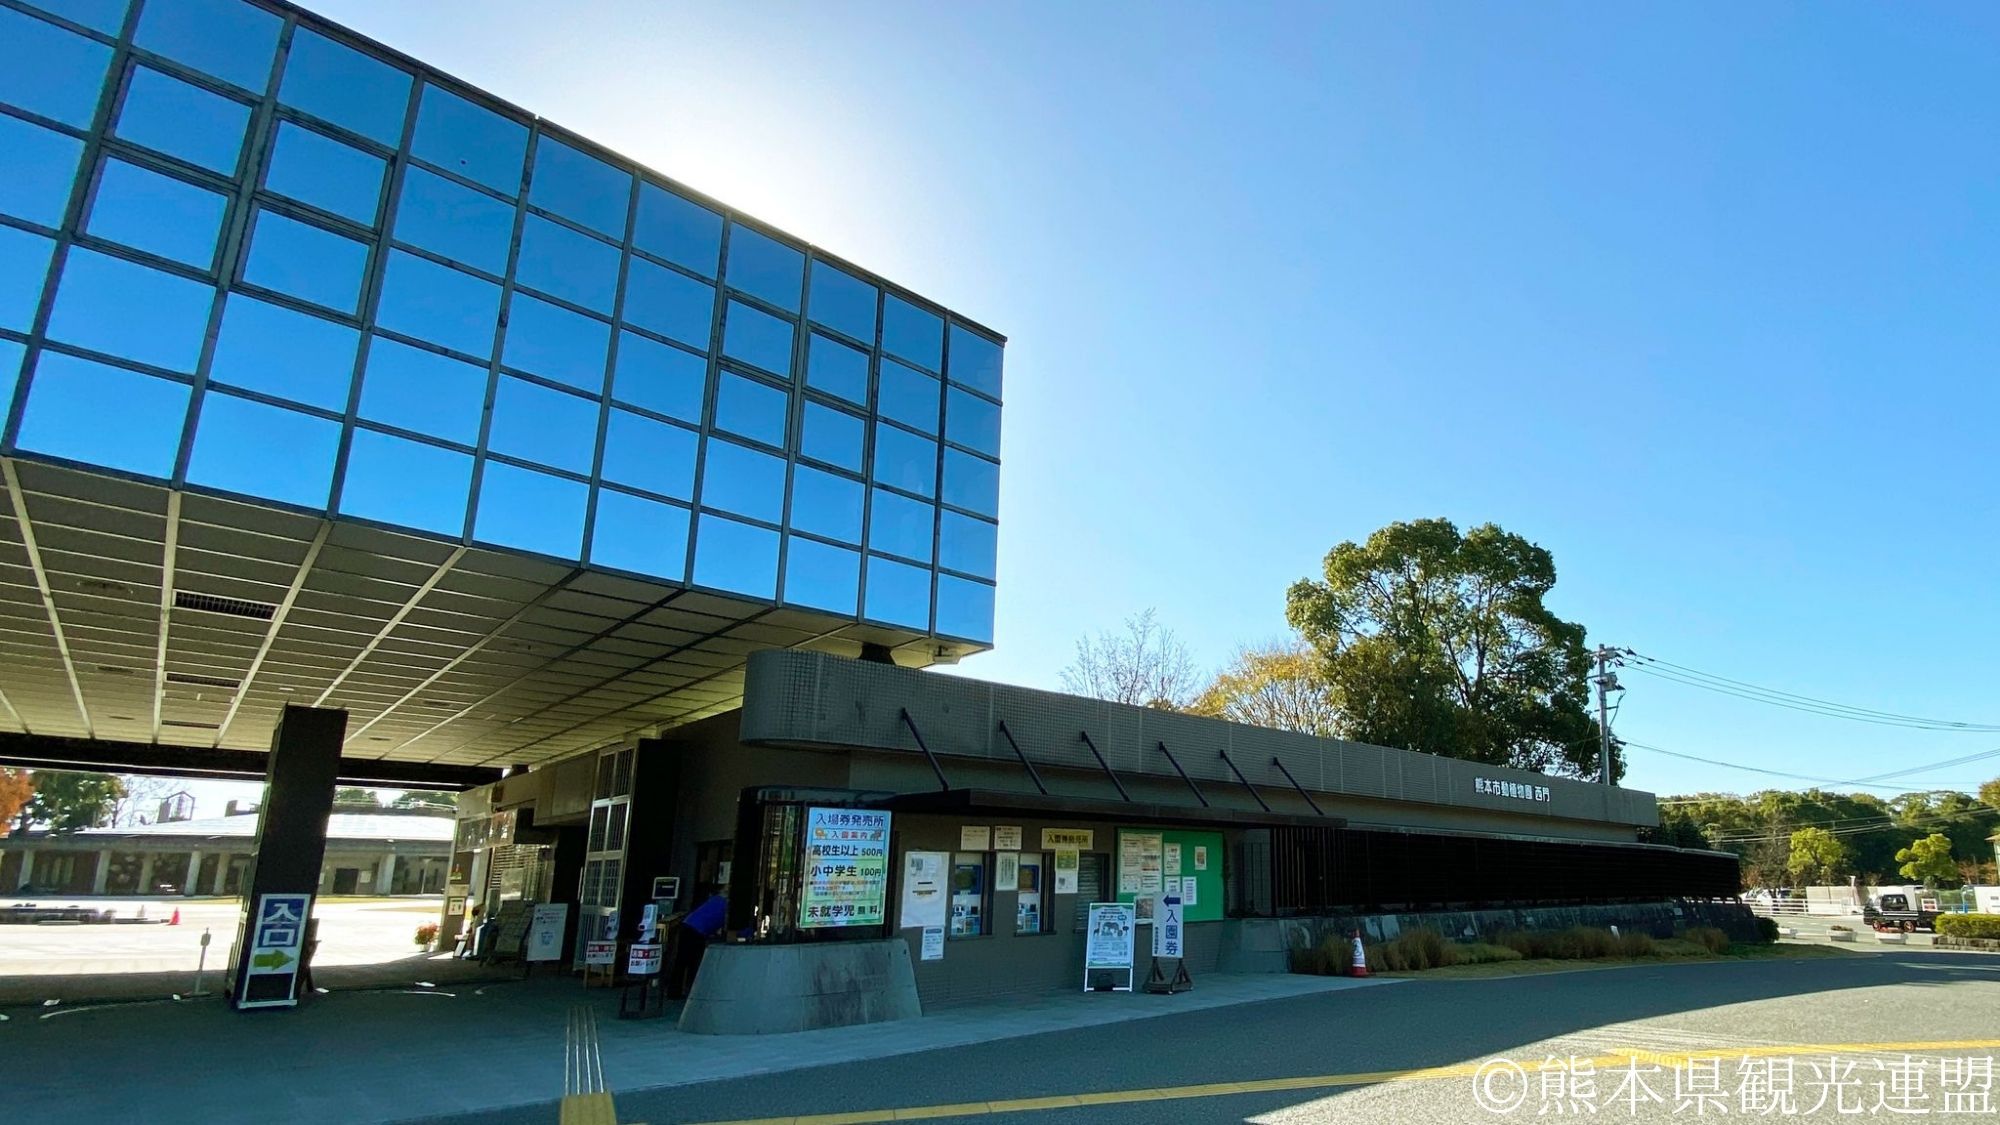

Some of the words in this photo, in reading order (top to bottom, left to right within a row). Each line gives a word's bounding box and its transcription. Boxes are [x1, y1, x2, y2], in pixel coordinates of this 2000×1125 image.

[1475, 777, 1533, 800] 熊本市動植物園
[1535, 786, 1550, 802] 西門
[816, 814, 884, 828] 入場券発売所
[812, 843, 858, 856] 高校生以上
[861, 847, 883, 856] 500円
[810, 864, 857, 877] 小中学生
[861, 867, 882, 877] 100円
[807, 904, 855, 918] 未就学児
[262, 903, 299, 946] 入口
[1165, 909, 1178, 956] 入園券
